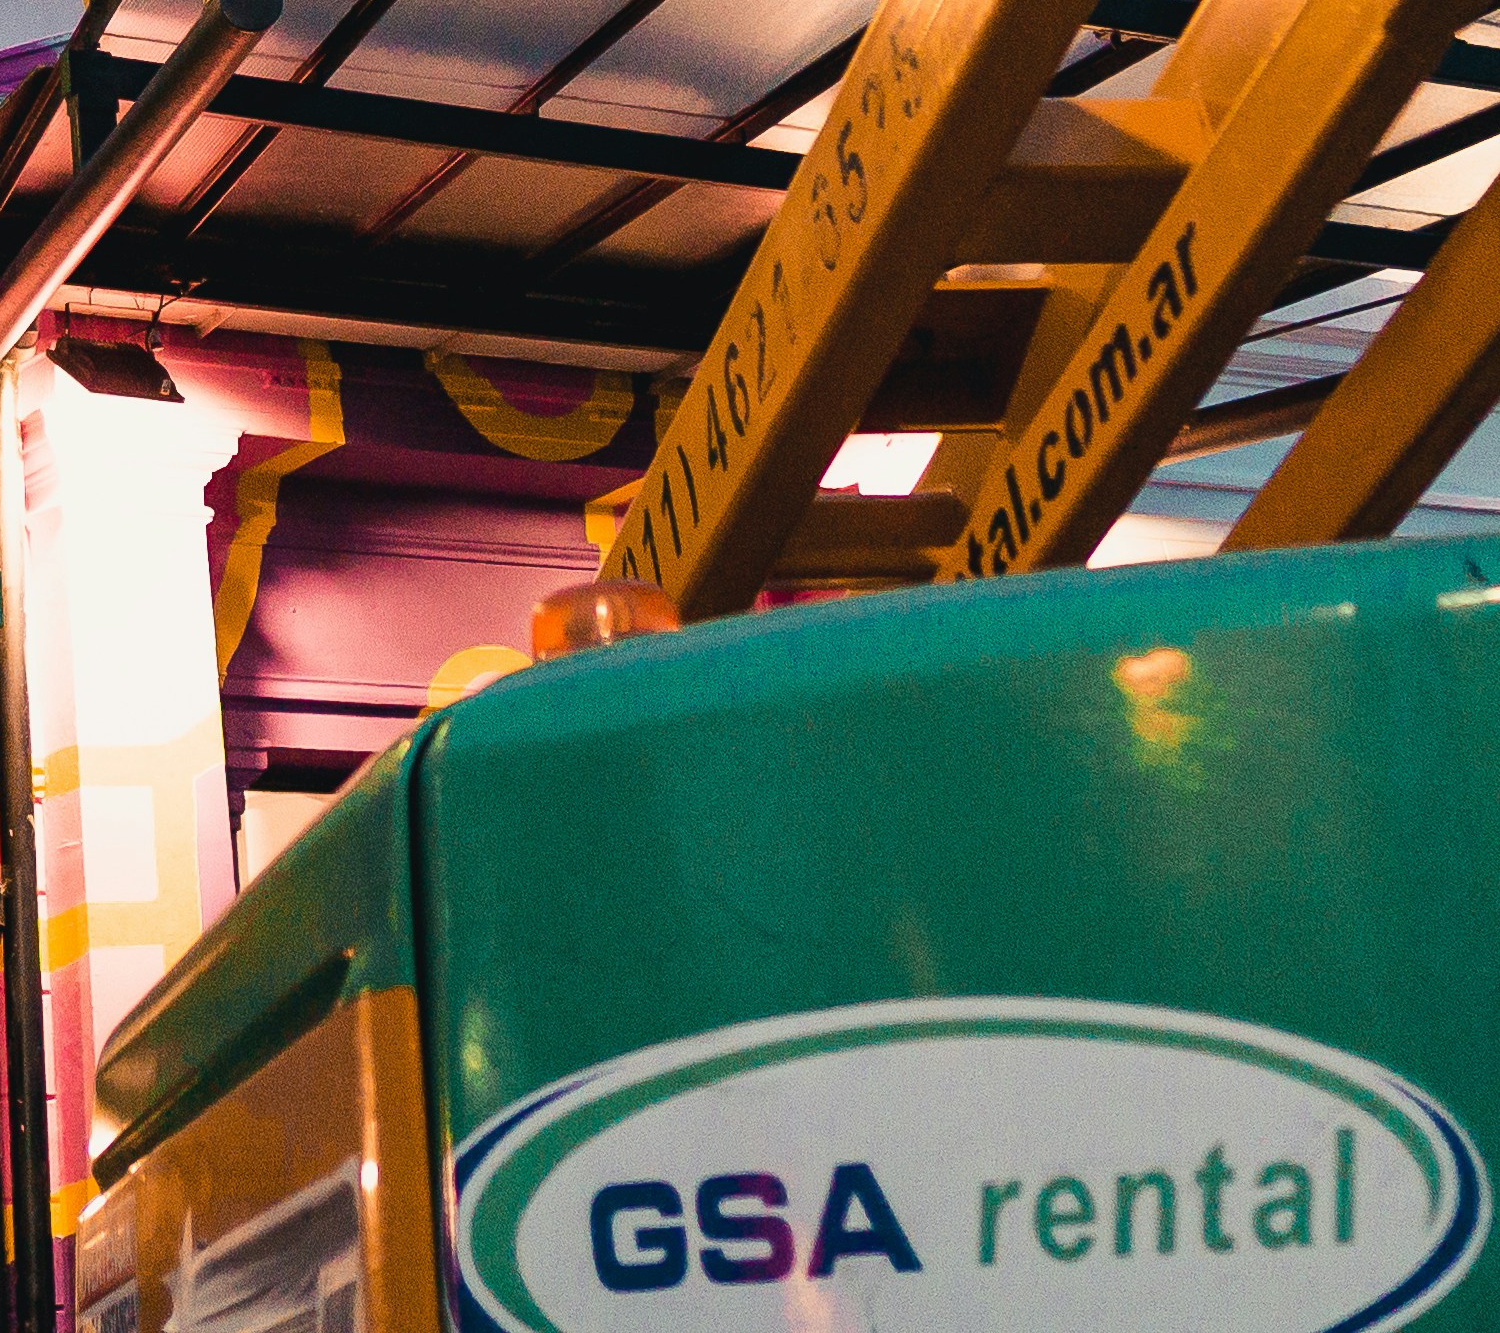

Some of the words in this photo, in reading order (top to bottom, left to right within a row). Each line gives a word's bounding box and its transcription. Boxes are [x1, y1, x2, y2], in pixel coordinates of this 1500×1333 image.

[955, 221, 1198, 581] tal.com.ar
[588, 1160, 924, 1294] GSA
[975, 1126, 1357, 1268] rental
